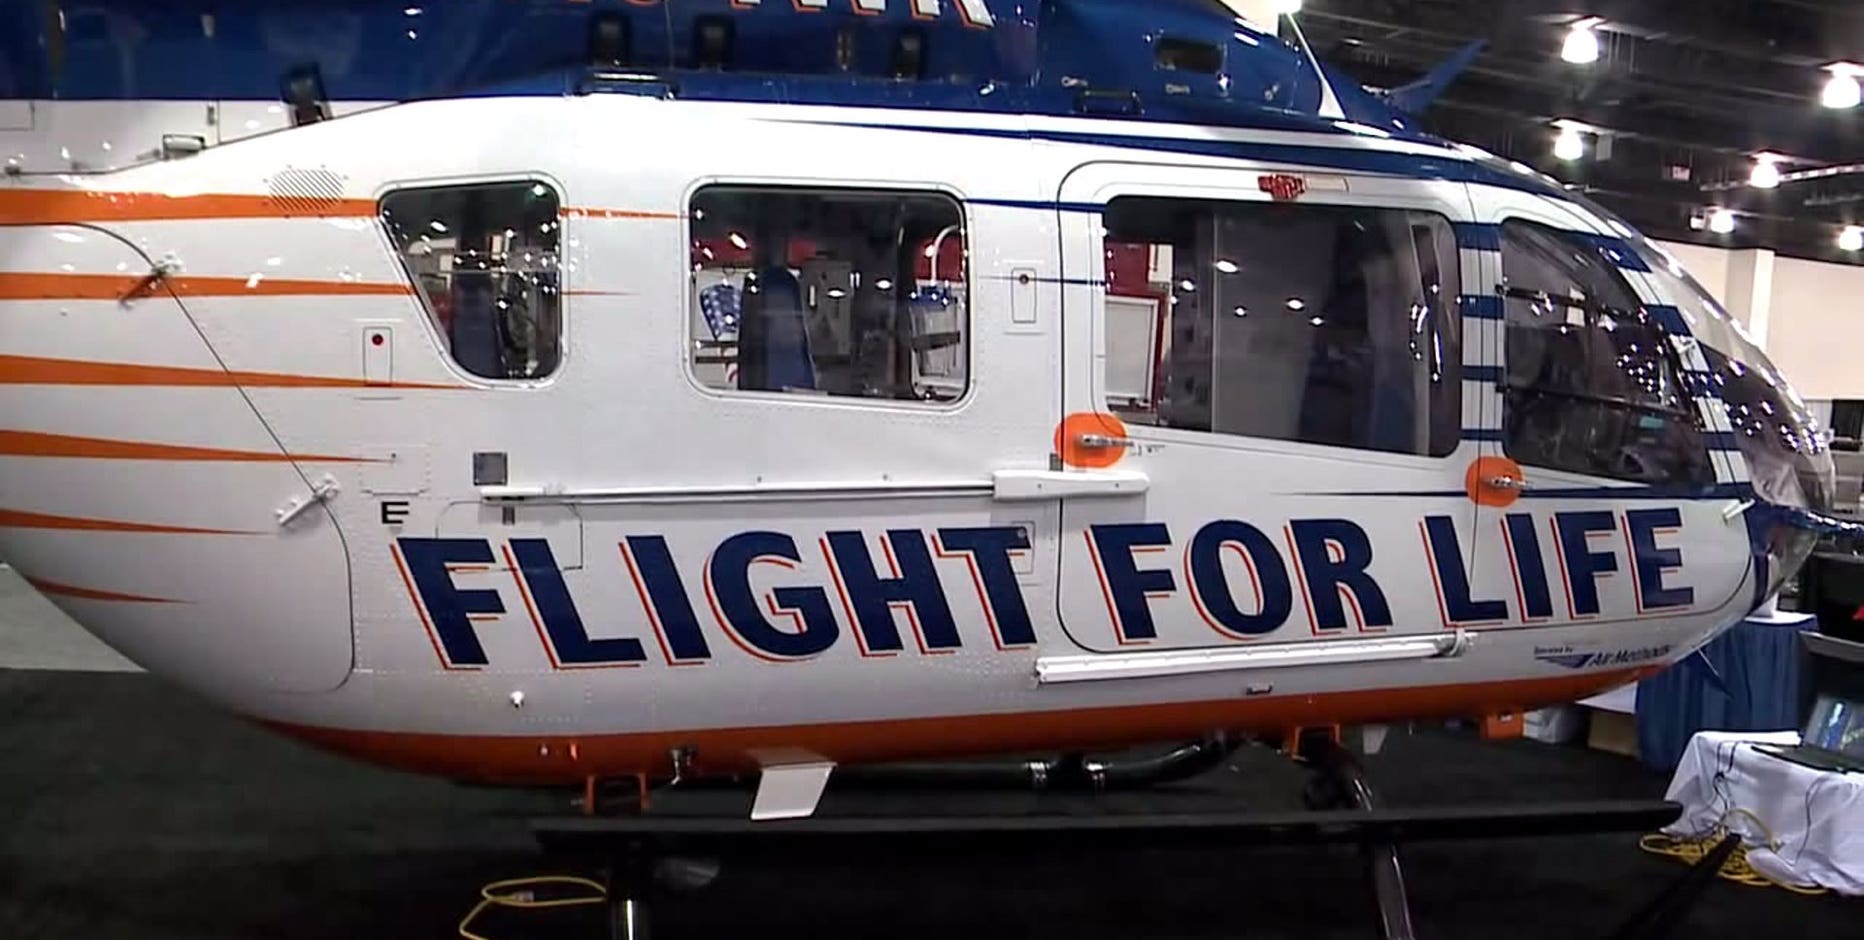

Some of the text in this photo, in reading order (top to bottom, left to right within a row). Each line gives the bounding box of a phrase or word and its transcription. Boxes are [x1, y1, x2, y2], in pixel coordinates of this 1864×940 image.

[381, 501, 409, 524] E
[391, 507, 1694, 670] FLIGHT FOR LIFE
